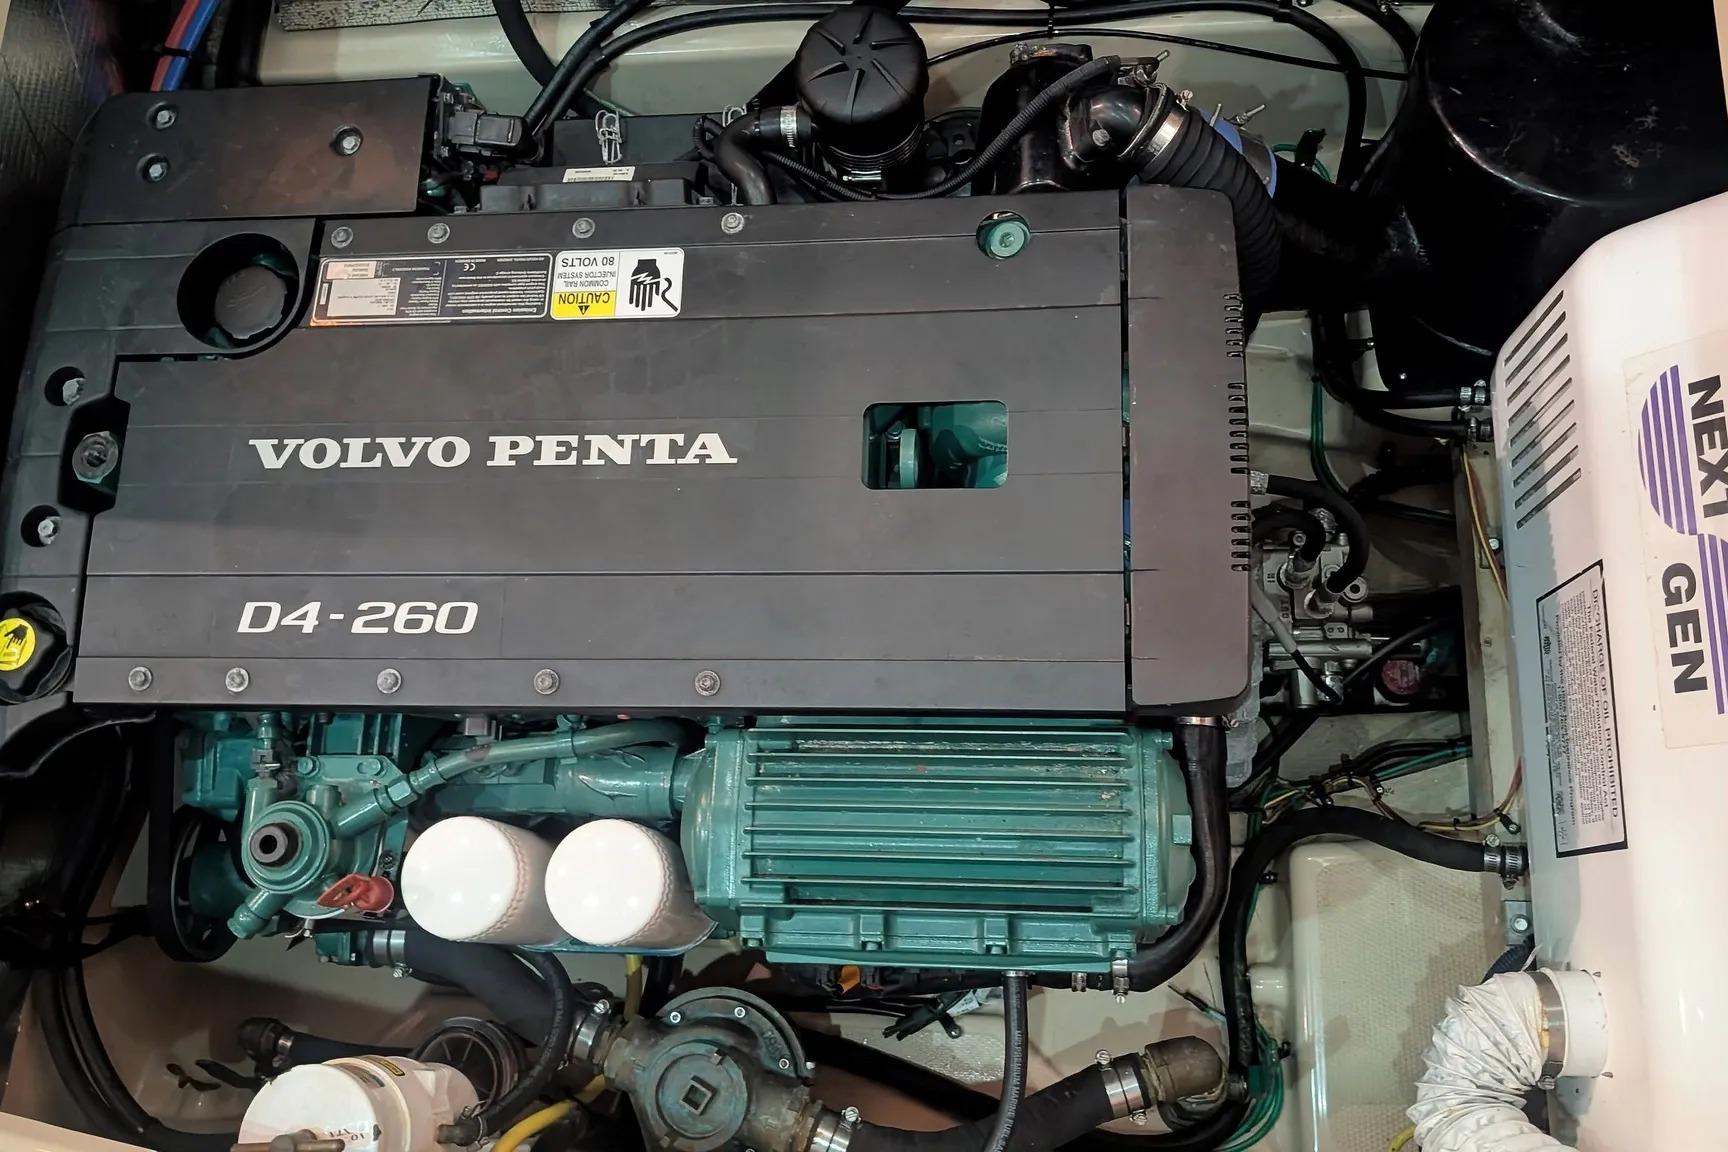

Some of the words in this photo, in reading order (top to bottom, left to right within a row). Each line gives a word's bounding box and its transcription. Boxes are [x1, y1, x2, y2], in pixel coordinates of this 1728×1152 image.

[561, 257, 598, 267] VOLTS
[601, 256, 615, 266] 80
[557, 271, 586, 280] SYSTEM
[586, 270, 616, 279] INJECTOR
[558, 292, 610, 305] CAUTION
[248, 435, 471, 470] VOLVO
[486, 433, 738, 467] PENTA
[237, 601, 479, 634] D4-260
[1661, 562, 1709, 694] GEN
[1600, 676, 1608, 695] OF
[1603, 700, 1611, 724] OIL
[1605, 728, 1619, 818] PROHIBITED
